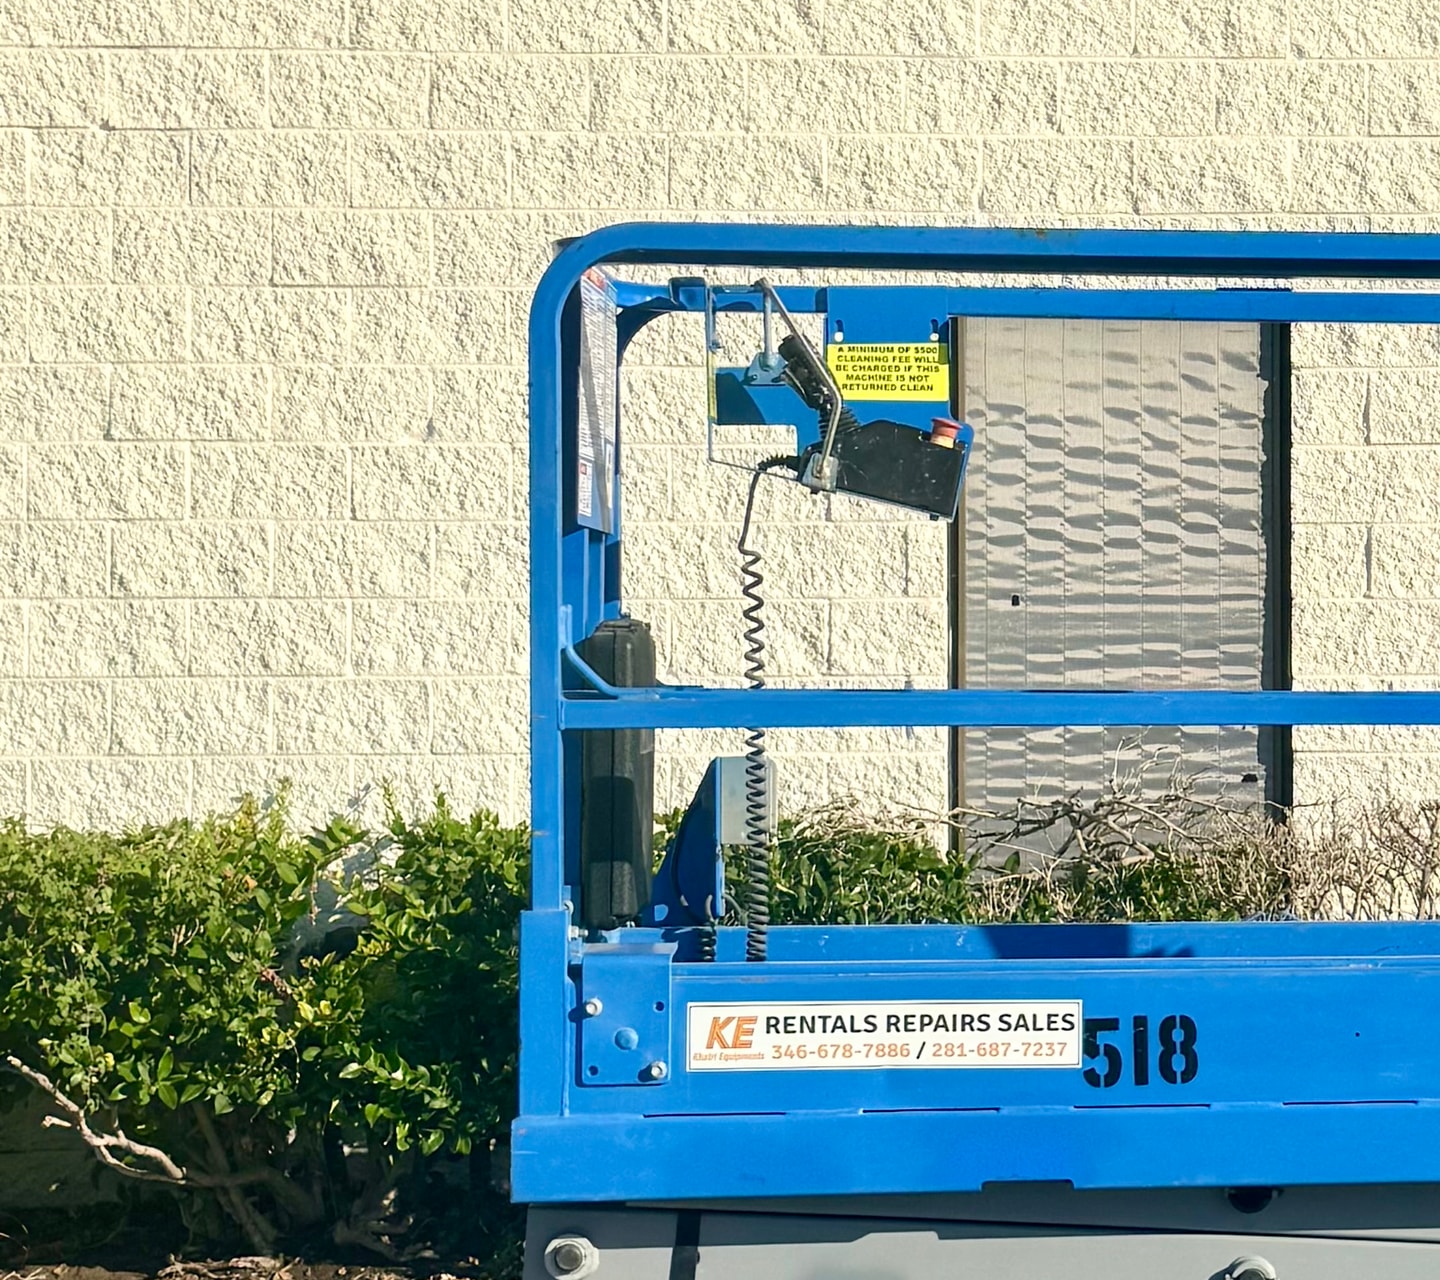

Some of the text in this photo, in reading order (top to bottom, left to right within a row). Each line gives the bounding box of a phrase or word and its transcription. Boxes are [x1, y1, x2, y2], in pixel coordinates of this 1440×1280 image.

[837, 355, 889, 363] CLEANING
[836, 364, 849, 372] BE
[917, 365, 940, 373] THIS
[846, 374, 892, 382] MACHINE
[842, 383, 897, 391] RETURNED
[766, 1013, 1075, 1034] RENTALS REPAIRS SALES
[706, 1016, 758, 1049] KE
[772, 1041, 1068, 1059] 346-678-7886 / 281-687-7237
[1083, 1014, 1198, 1088] 518
